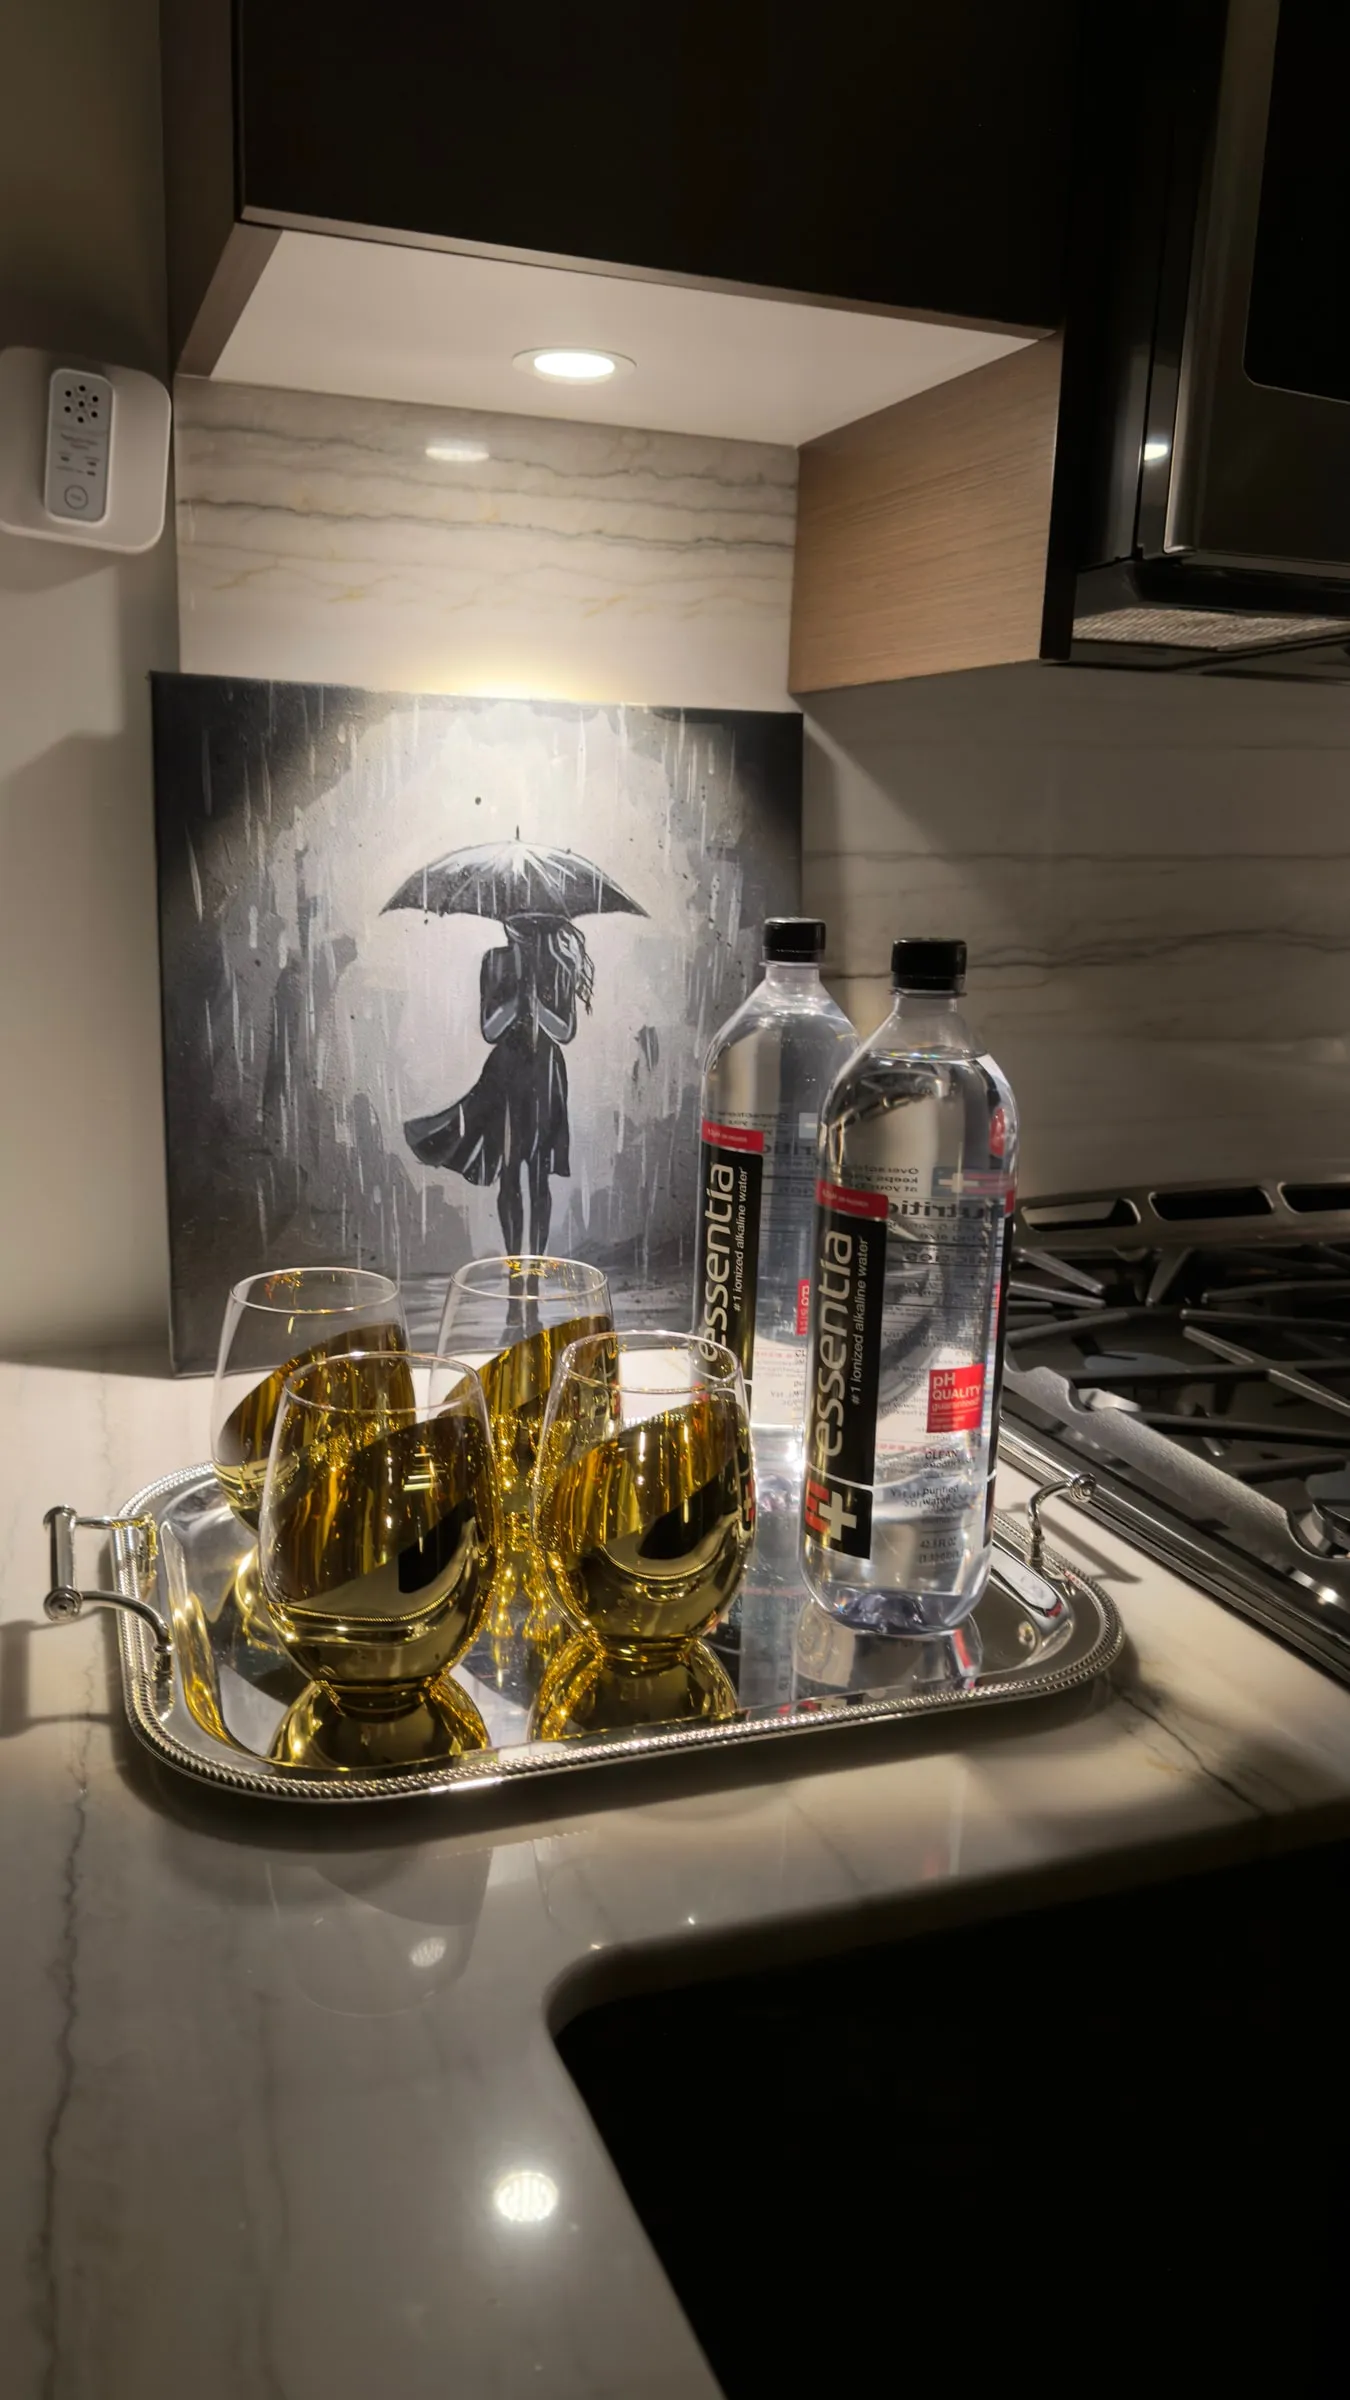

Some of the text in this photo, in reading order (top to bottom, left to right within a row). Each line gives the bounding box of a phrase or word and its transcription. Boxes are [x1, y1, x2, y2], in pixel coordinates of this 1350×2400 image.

[738, 1169, 749, 1202] water
[734, 1204, 746, 1249] alkaline
[699, 1162, 734, 1362] essentia
[733, 1250, 745, 1293] ionized
[857, 1238, 869, 1277] water
[852, 1280, 868, 1332] alkaline
[814, 1230, 853, 1457] essentia
[851, 1334, 864, 1383] ionized
[932, 1372, 957, 1390] pH
[932, 1385, 982, 1401] QUALITY
